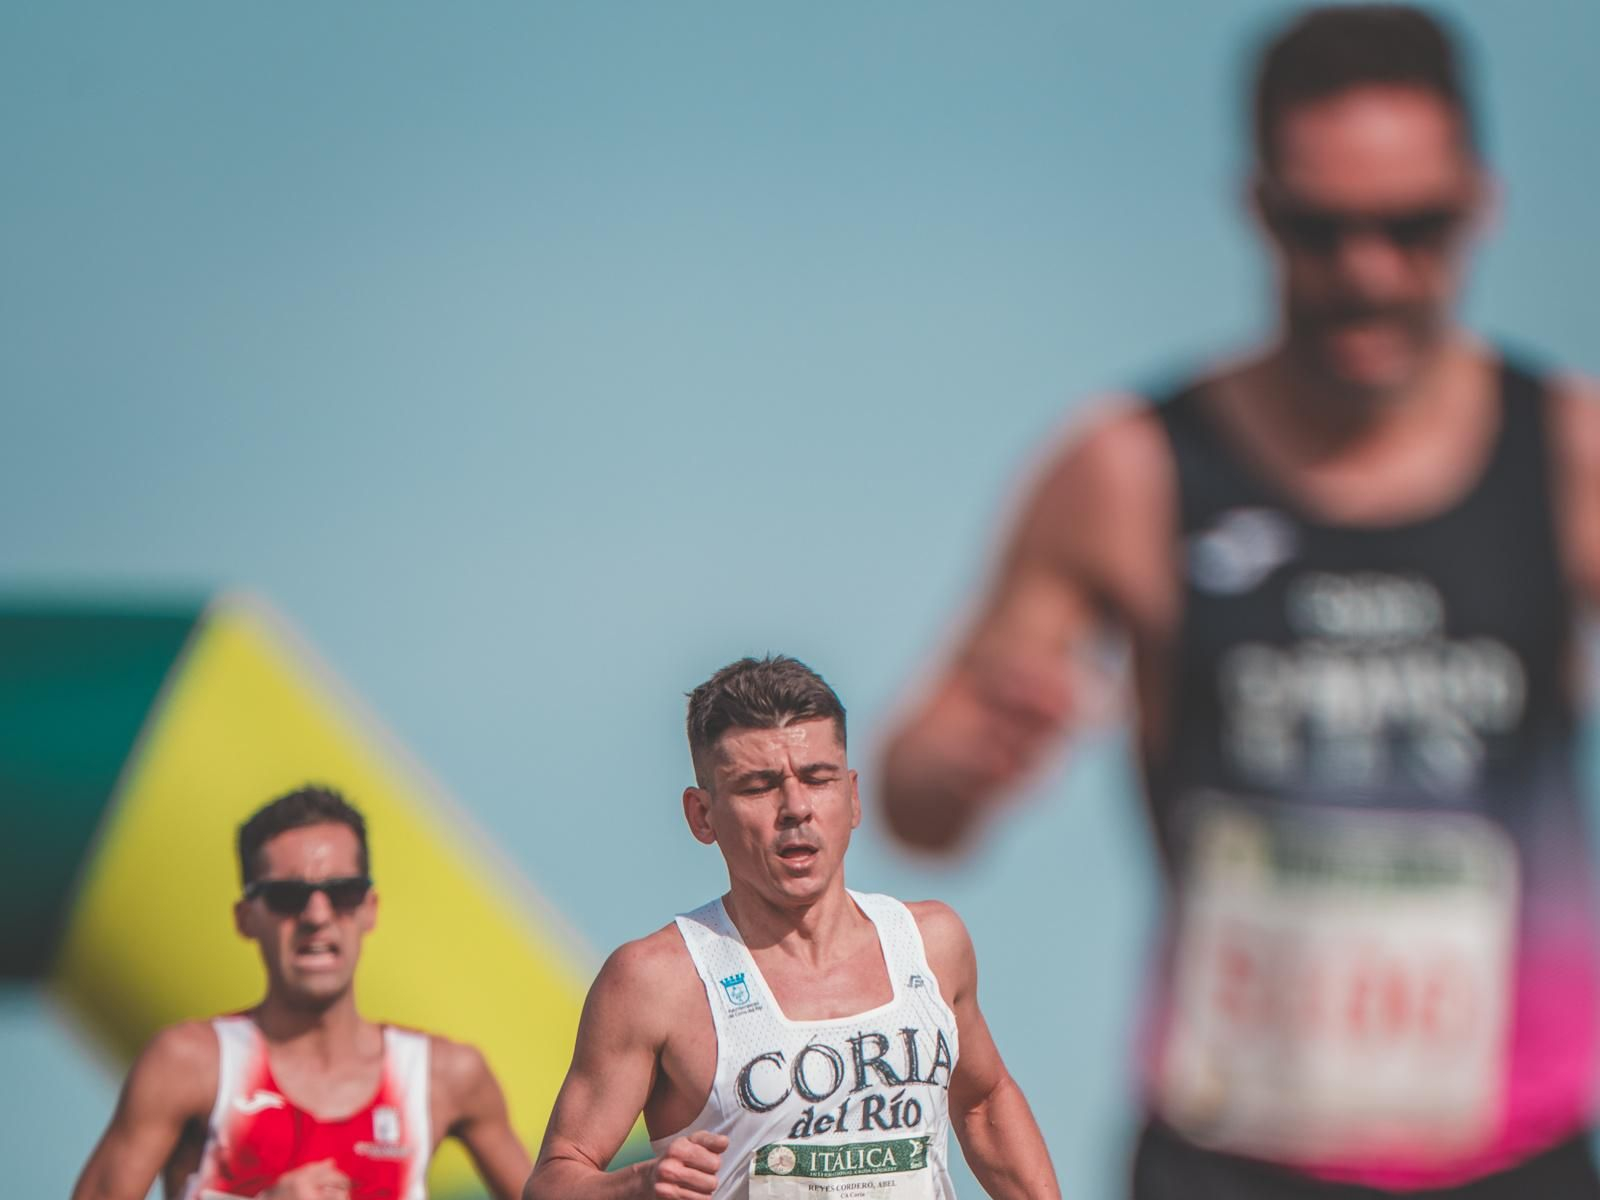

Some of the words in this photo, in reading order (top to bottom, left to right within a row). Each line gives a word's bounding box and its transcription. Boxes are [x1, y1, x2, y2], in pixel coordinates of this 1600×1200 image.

[734, 1027, 951, 1113] CORIA
[788, 1098, 850, 1139] del
[858, 1088, 922, 1131] Río
[810, 1147, 897, 1172] ITÁLICA
